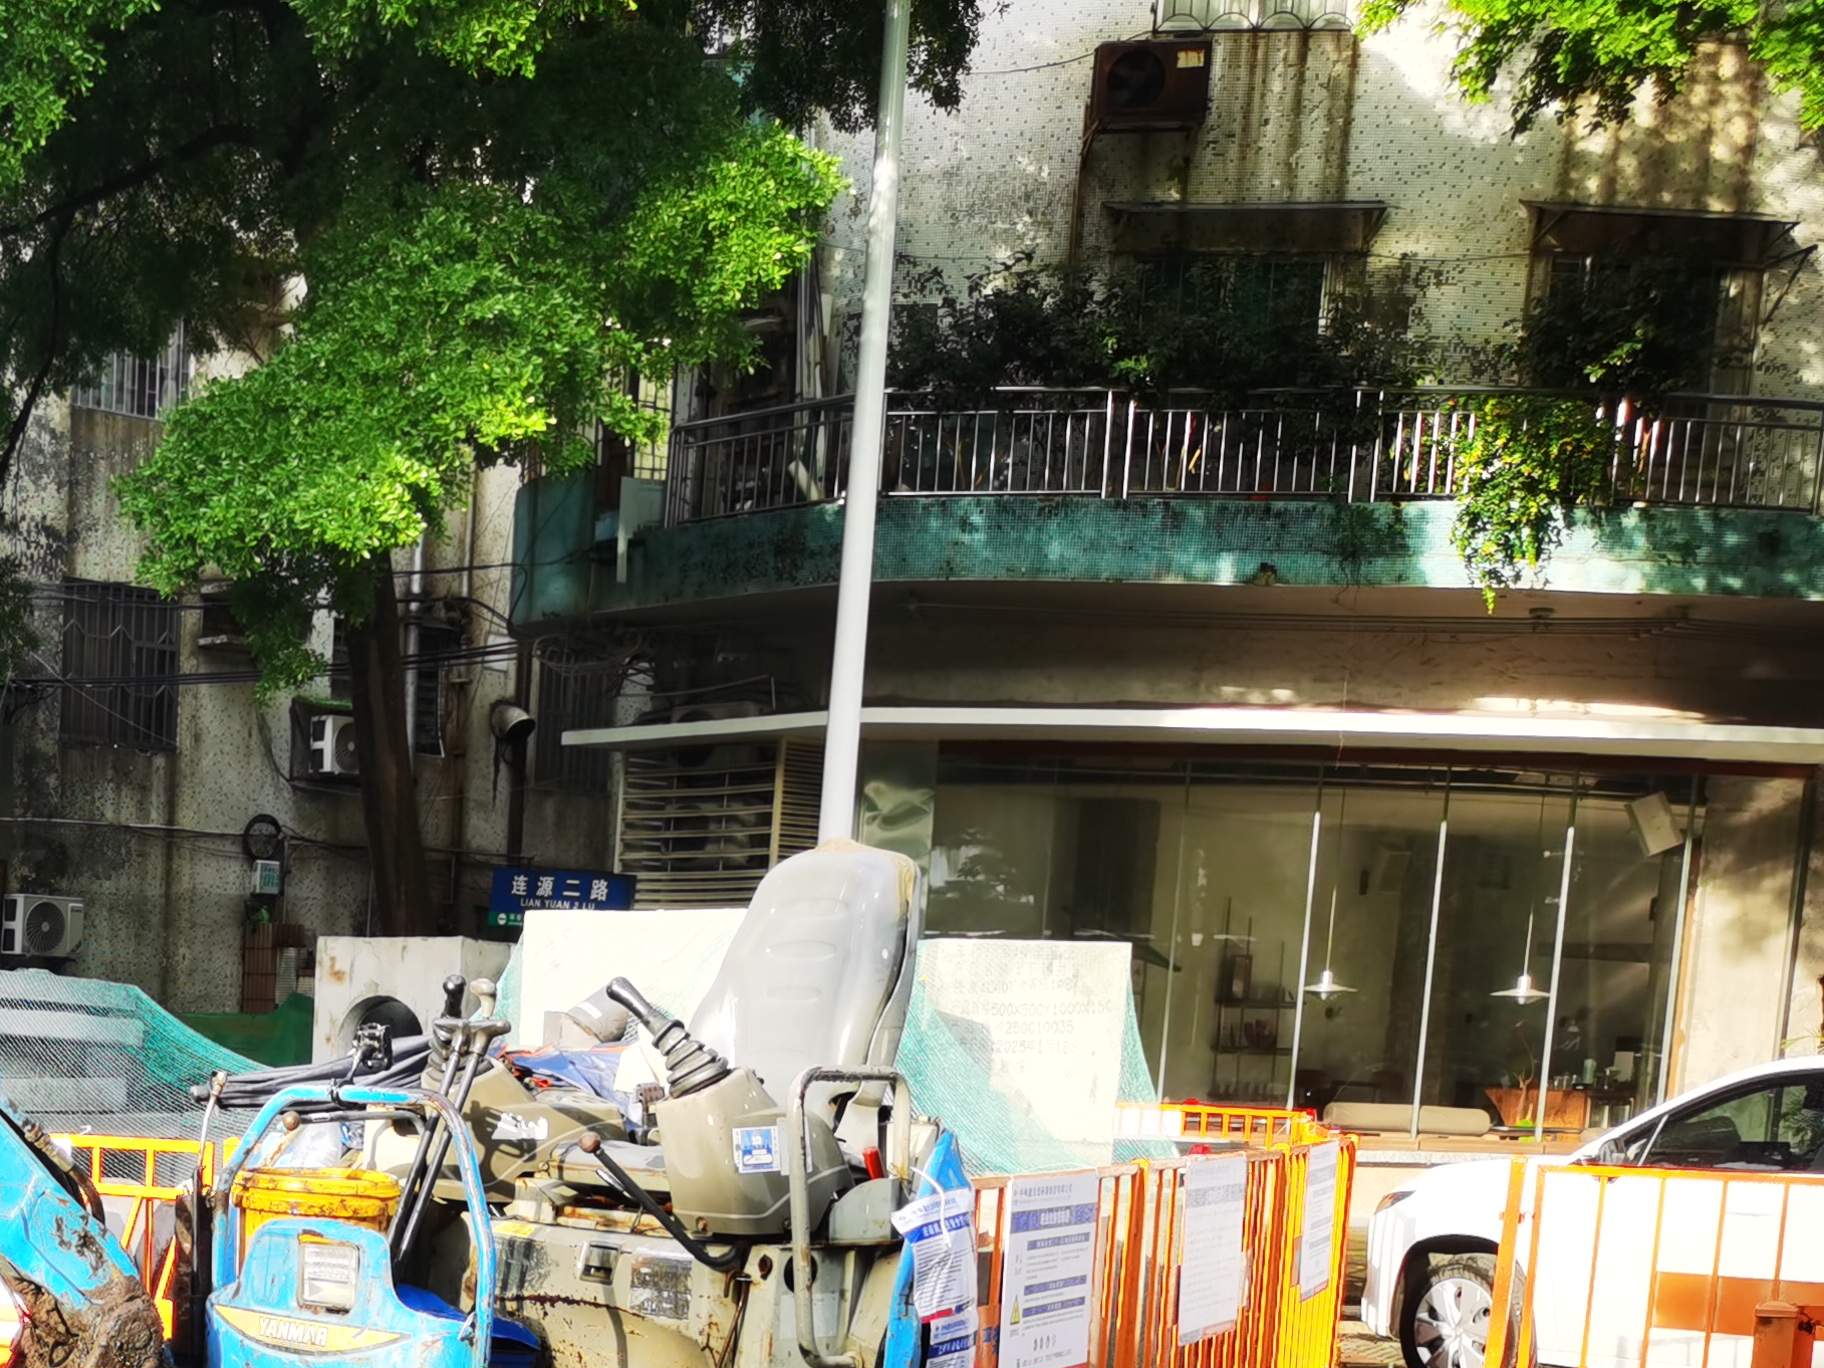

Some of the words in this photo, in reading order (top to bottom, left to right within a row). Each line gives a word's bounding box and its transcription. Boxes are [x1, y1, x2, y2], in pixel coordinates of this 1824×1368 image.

[511, 875, 609, 901] 连源二路
[520, 898, 541, 908] LIAN
[544, 900, 570, 909] YUAN
[259, 1317, 329, 1346] YANMAR
